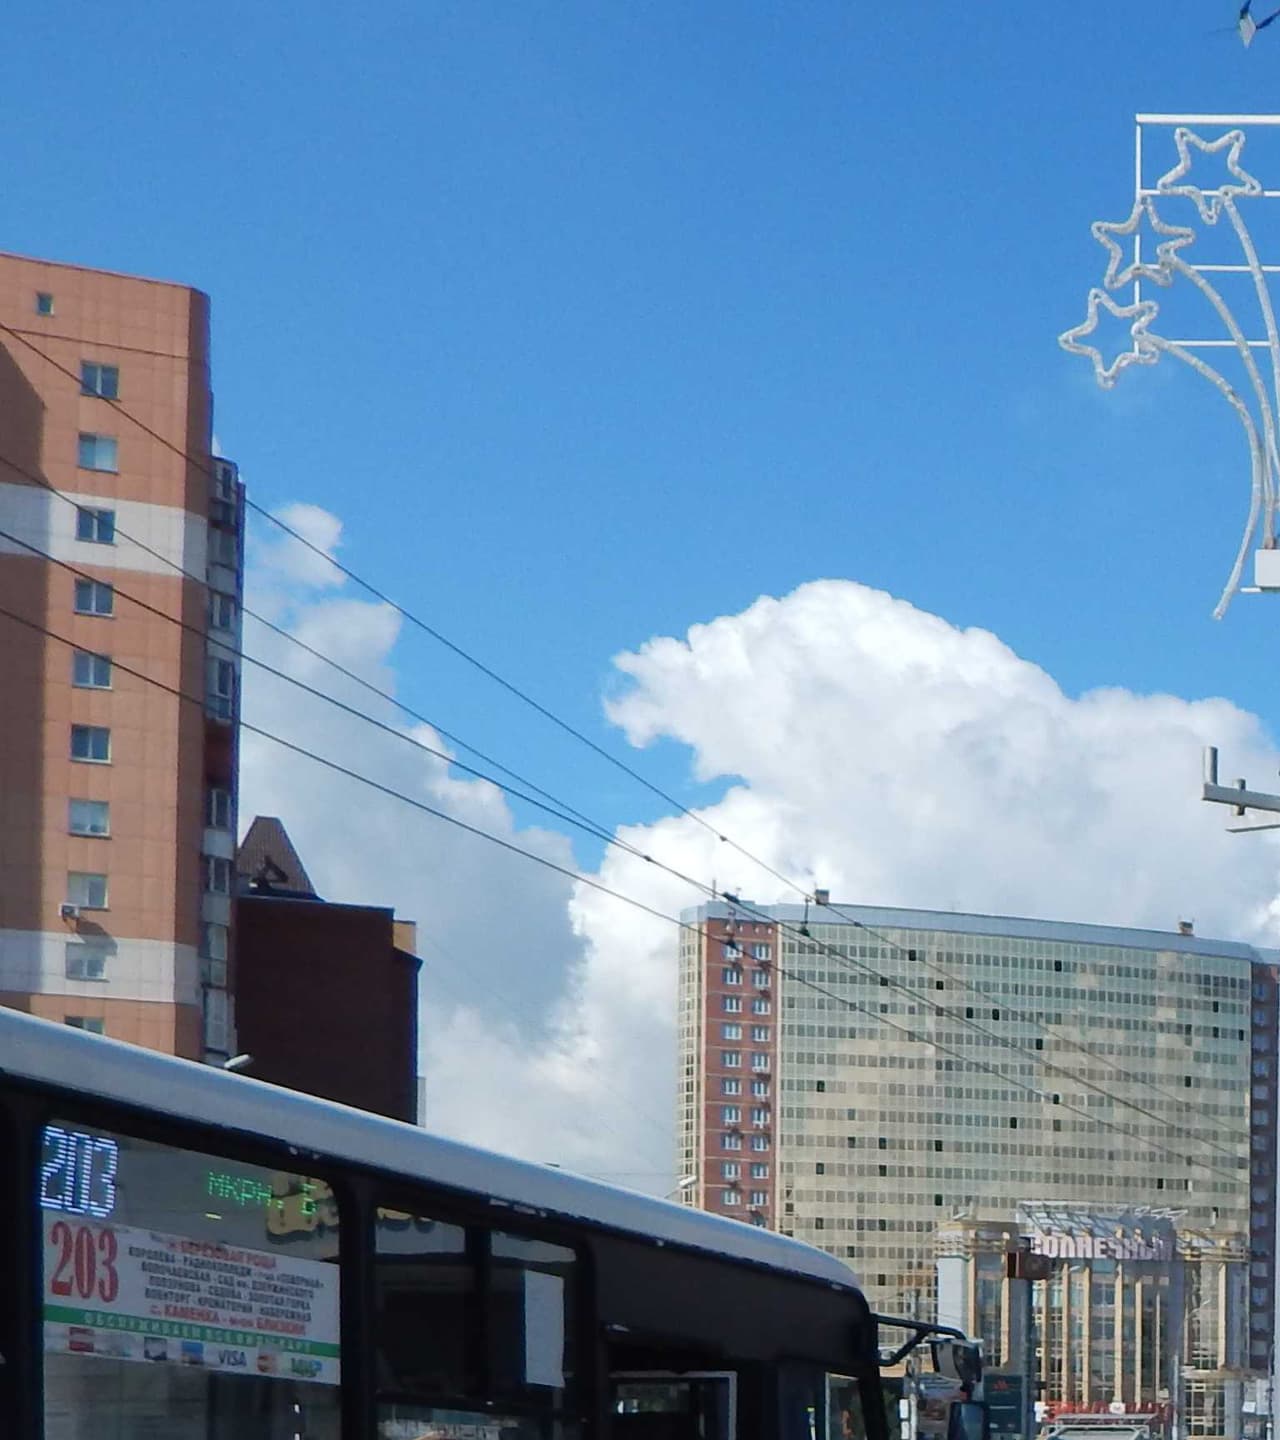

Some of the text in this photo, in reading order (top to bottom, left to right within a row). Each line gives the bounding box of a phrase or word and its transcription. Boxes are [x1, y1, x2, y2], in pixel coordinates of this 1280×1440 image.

[40, 1125, 119, 1218] 203
[49, 1221, 119, 1303] 203
[218, 1350, 247, 1368] VISA
